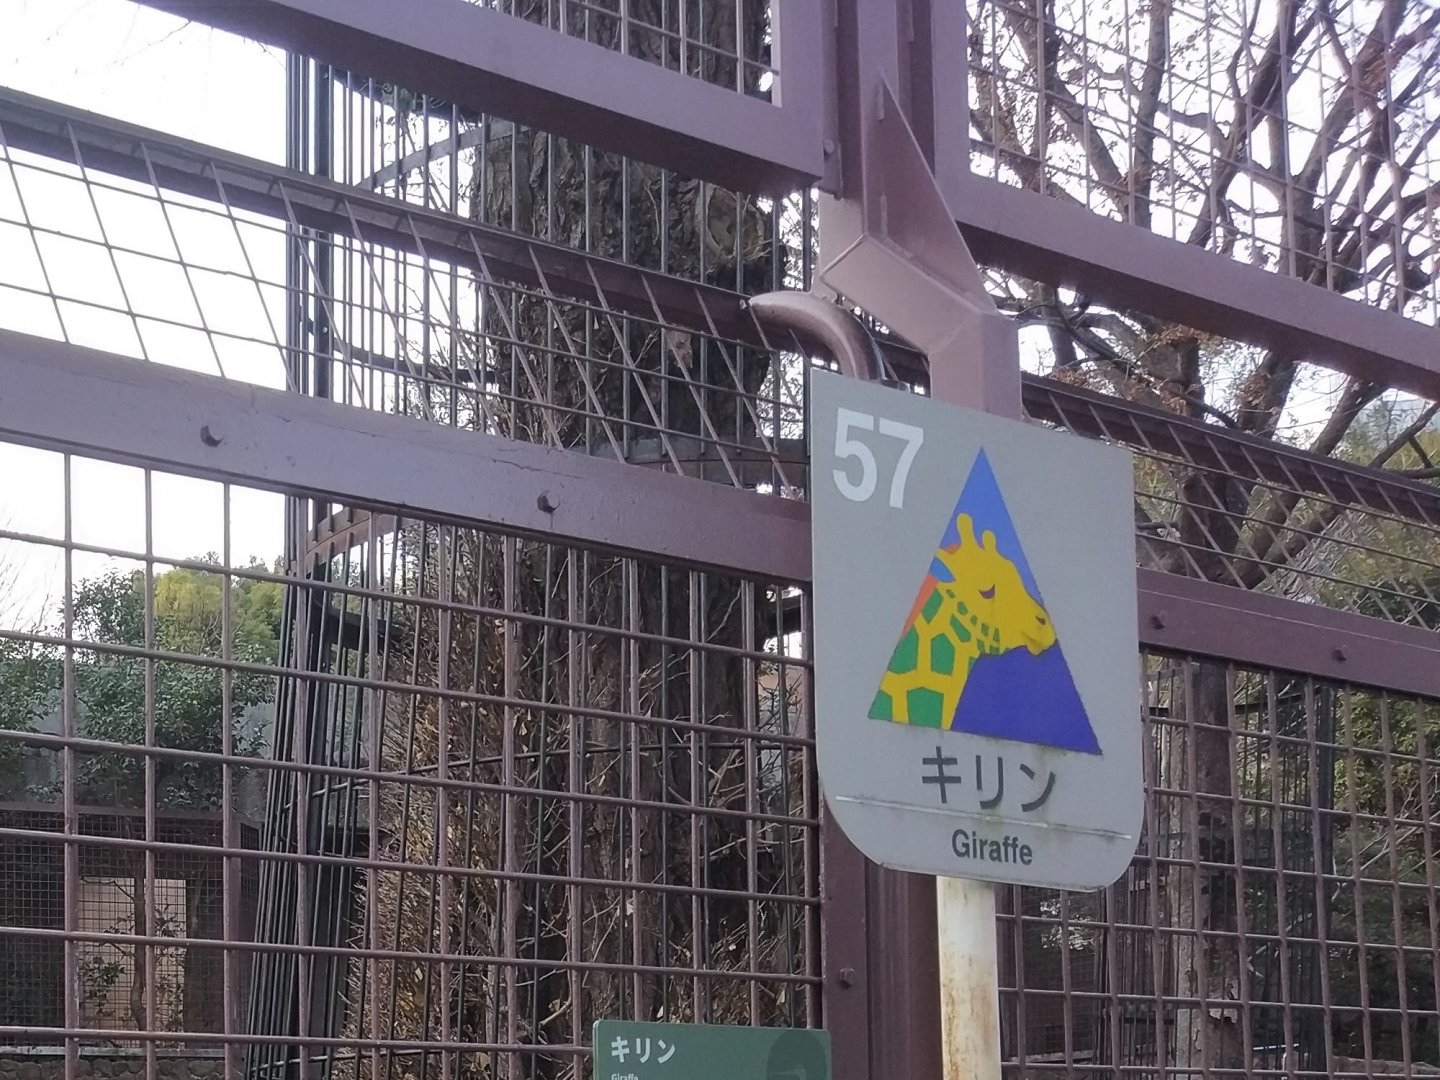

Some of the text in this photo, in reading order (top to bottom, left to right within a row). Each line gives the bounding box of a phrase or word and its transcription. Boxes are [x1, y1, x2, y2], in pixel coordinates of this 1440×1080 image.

[833, 408, 924, 509] 57
[922, 746, 1055, 812] キリン
[952, 829, 1033, 866] Giraffe
[611, 1036, 676, 1064] キリン
